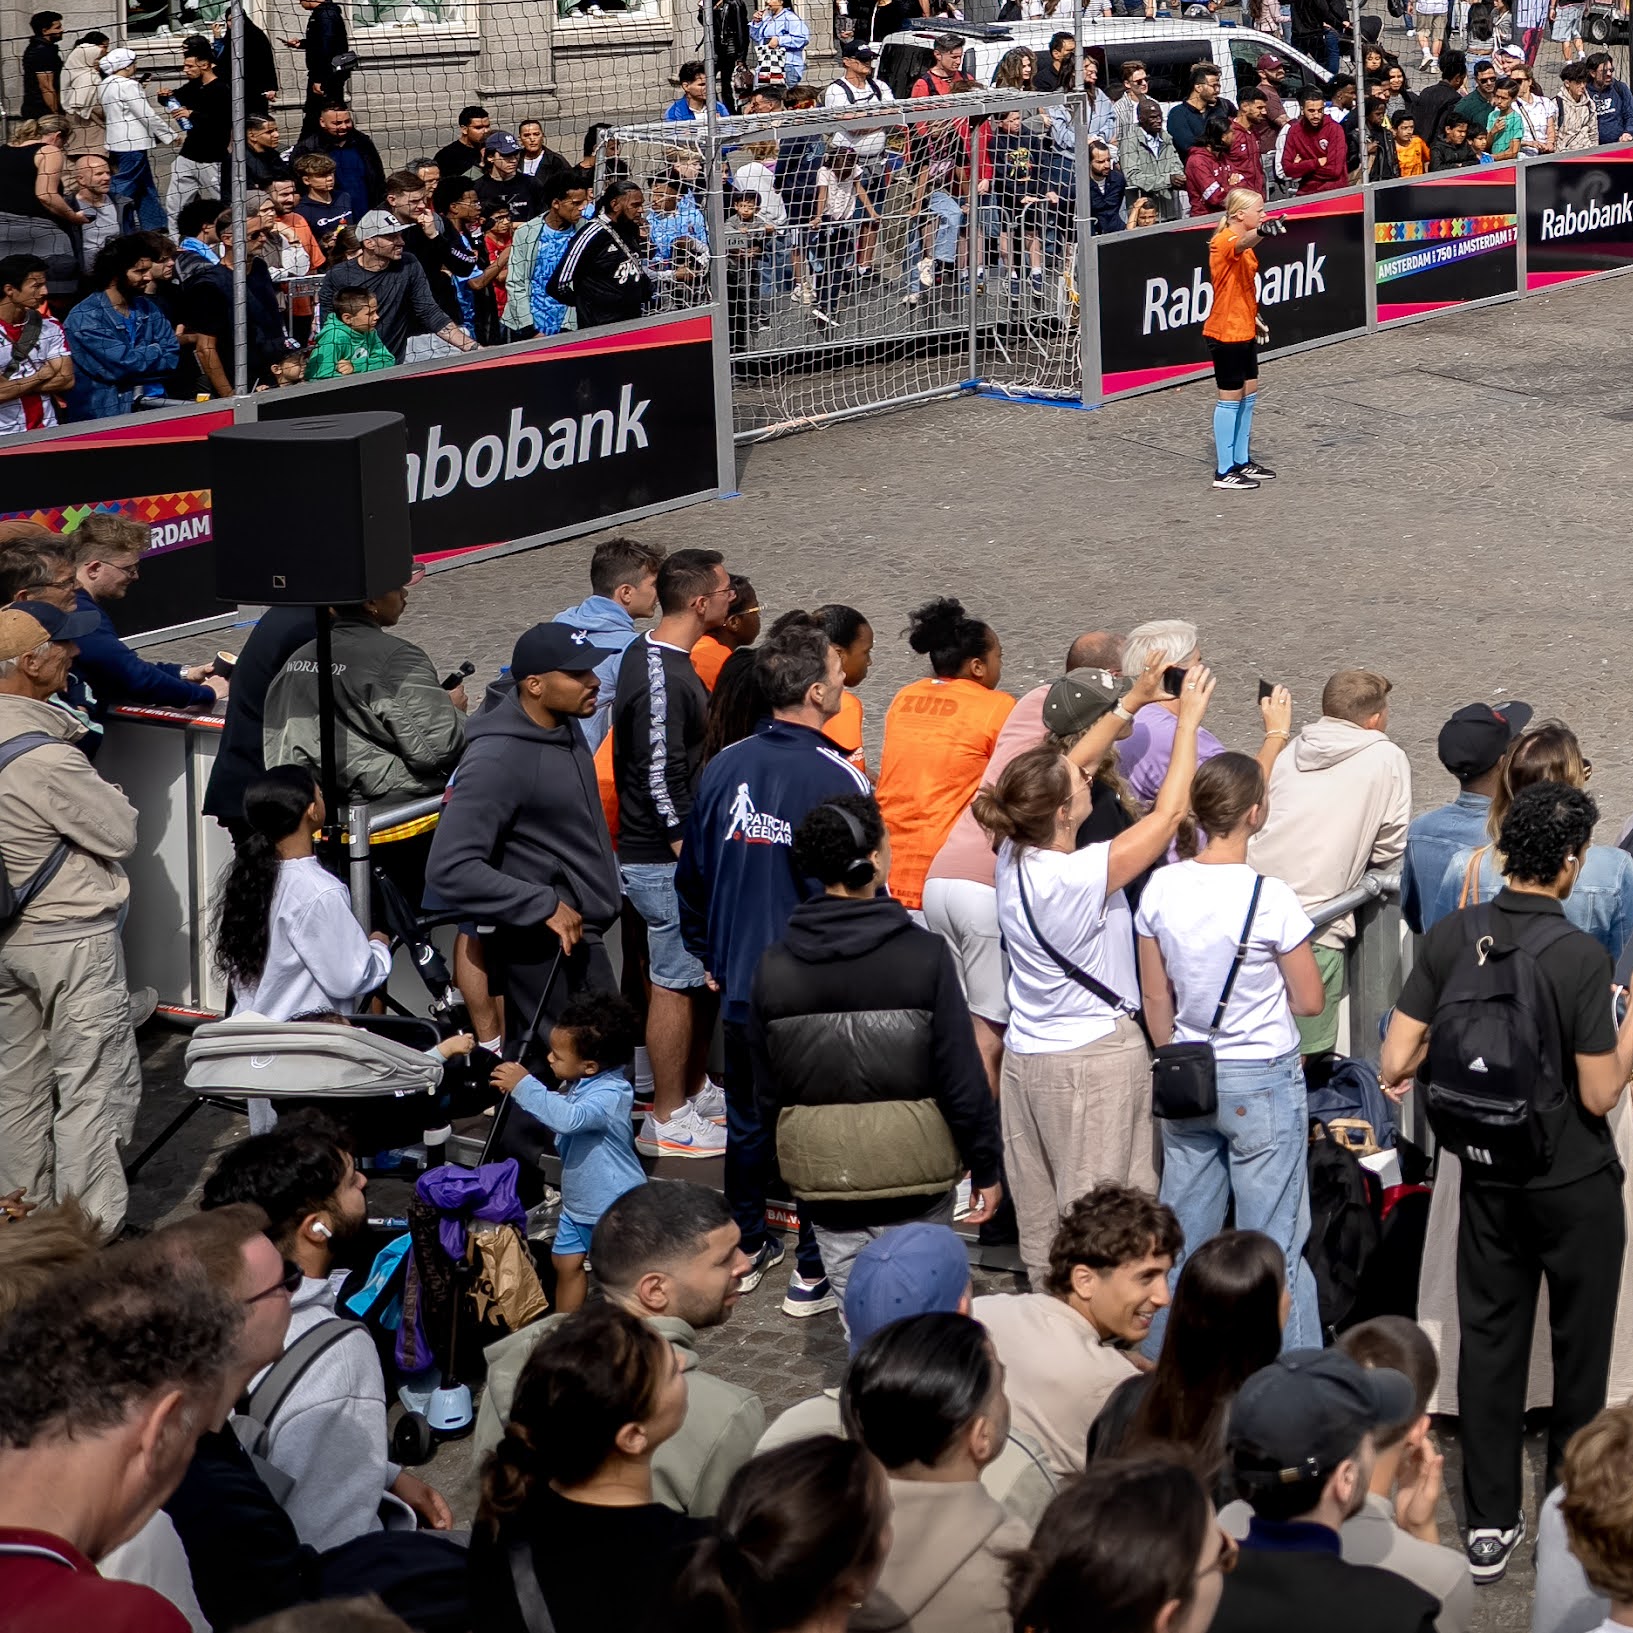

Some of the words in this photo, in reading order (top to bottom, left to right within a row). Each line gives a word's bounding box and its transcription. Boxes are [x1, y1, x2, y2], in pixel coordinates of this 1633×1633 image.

[1541, 192, 1633, 241] Rabobank
[1378, 255, 1432, 278] AMSTERDAM
[1436, 248, 1453, 266] 750
[1457, 232, 1508, 257] AMSTERDAM
[1142, 241, 1327, 336] Rabank
[404, 382, 652, 504] bobank
[151, 514, 213, 547] RDAM
[286, 659, 347, 677] WORKOP
[898, 694, 960, 718] ZUID
